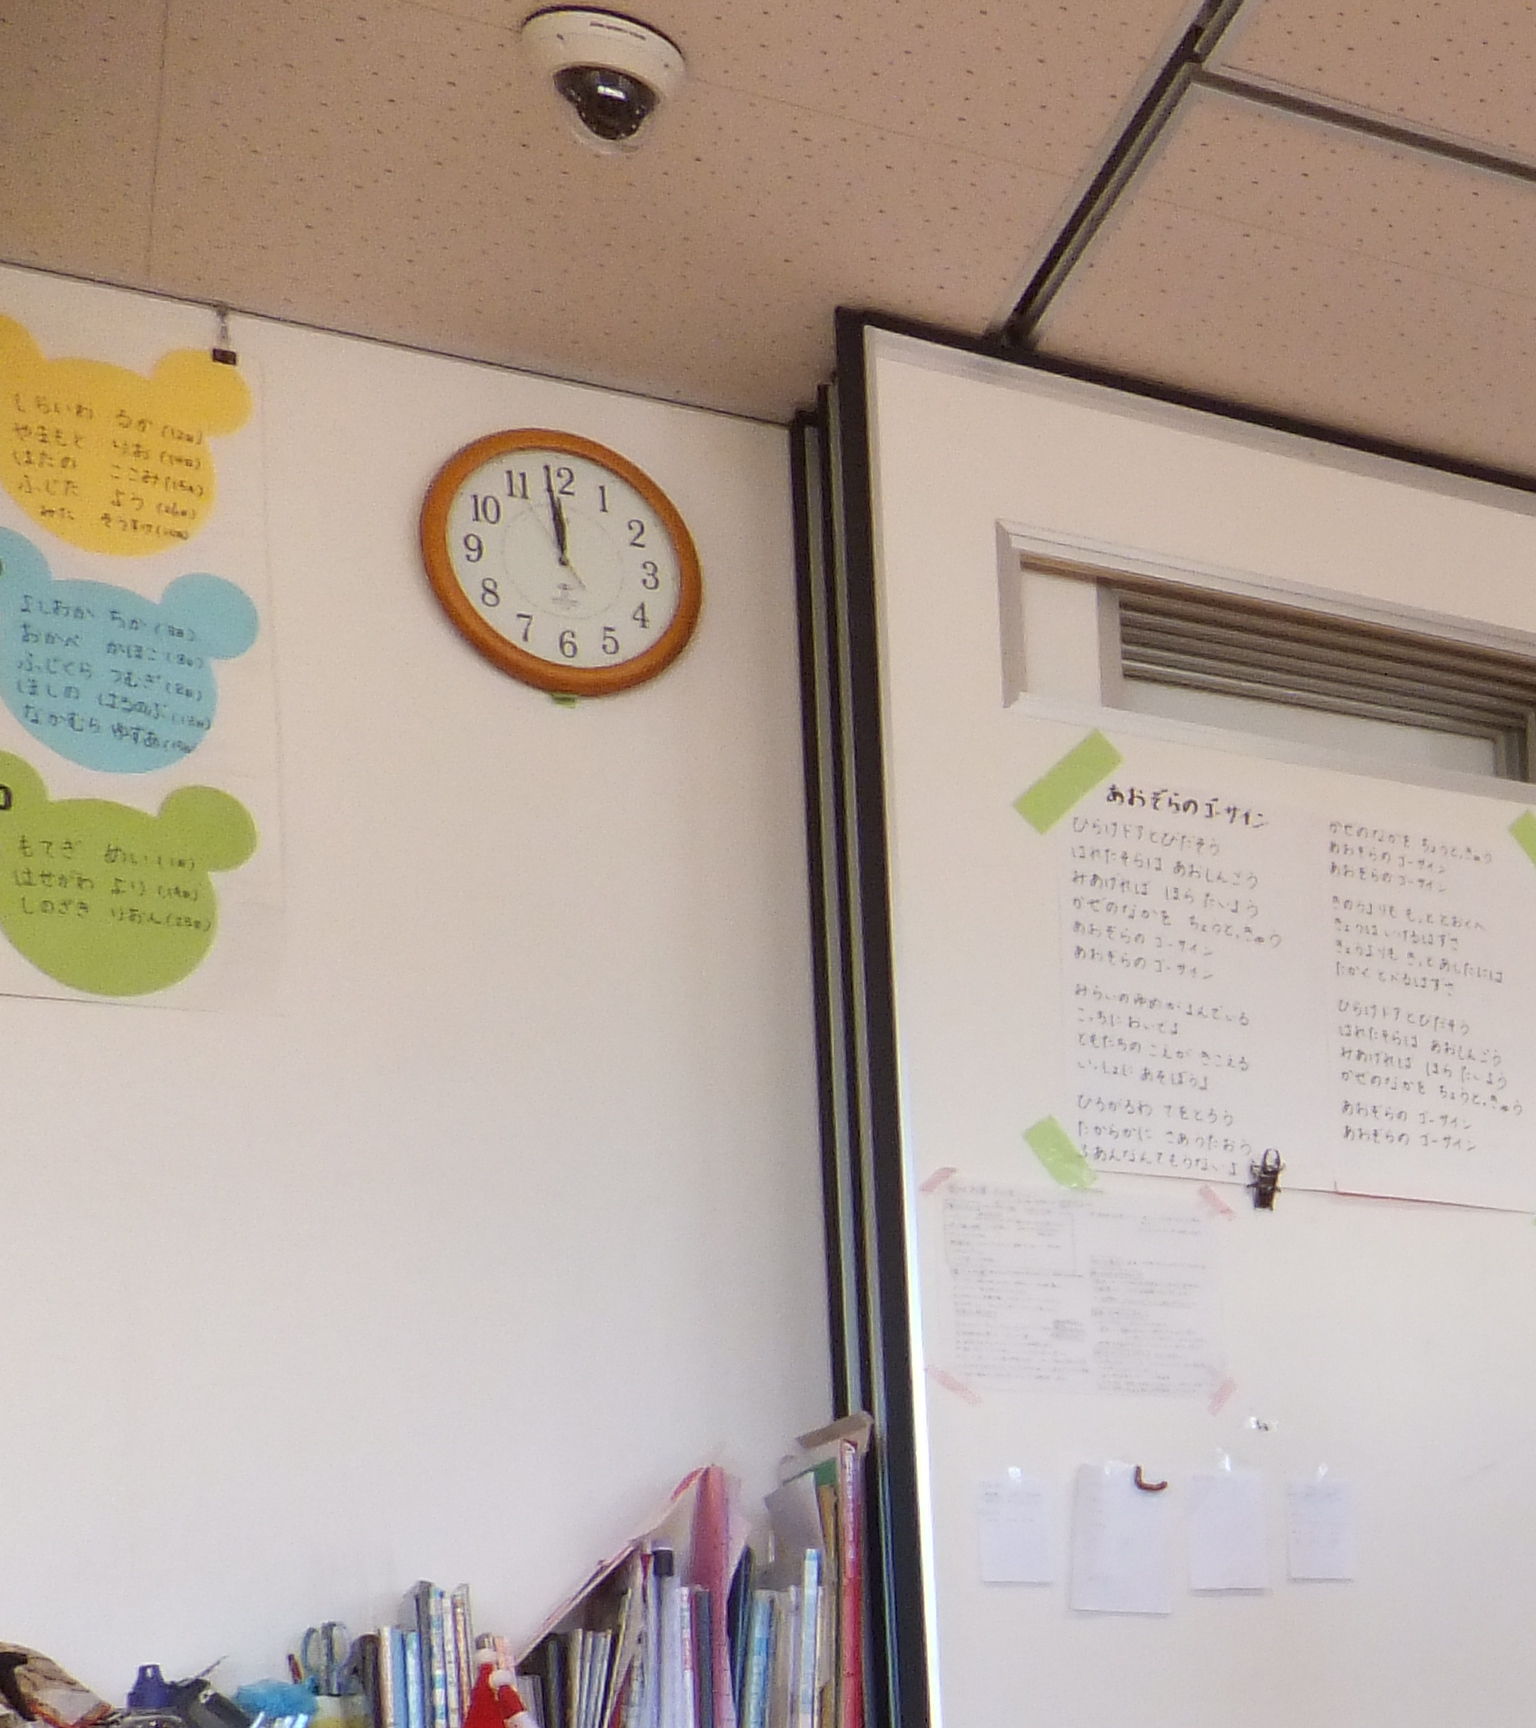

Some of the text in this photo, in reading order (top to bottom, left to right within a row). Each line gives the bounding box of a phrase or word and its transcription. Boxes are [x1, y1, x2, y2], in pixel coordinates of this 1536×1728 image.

[506, 470, 530, 499] 11
[471, 494, 501, 524] 10
[599, 486, 608, 512] 1
[464, 533, 483, 562] 9
[628, 520, 646, 548] 2
[642, 561, 660, 590] 3
[482, 578, 500, 607] 8
[516, 614, 533, 642] 7
[632, 602, 650, 628] 4
[559, 630, 578, 658] 6
[602, 627, 619, 655] 5
